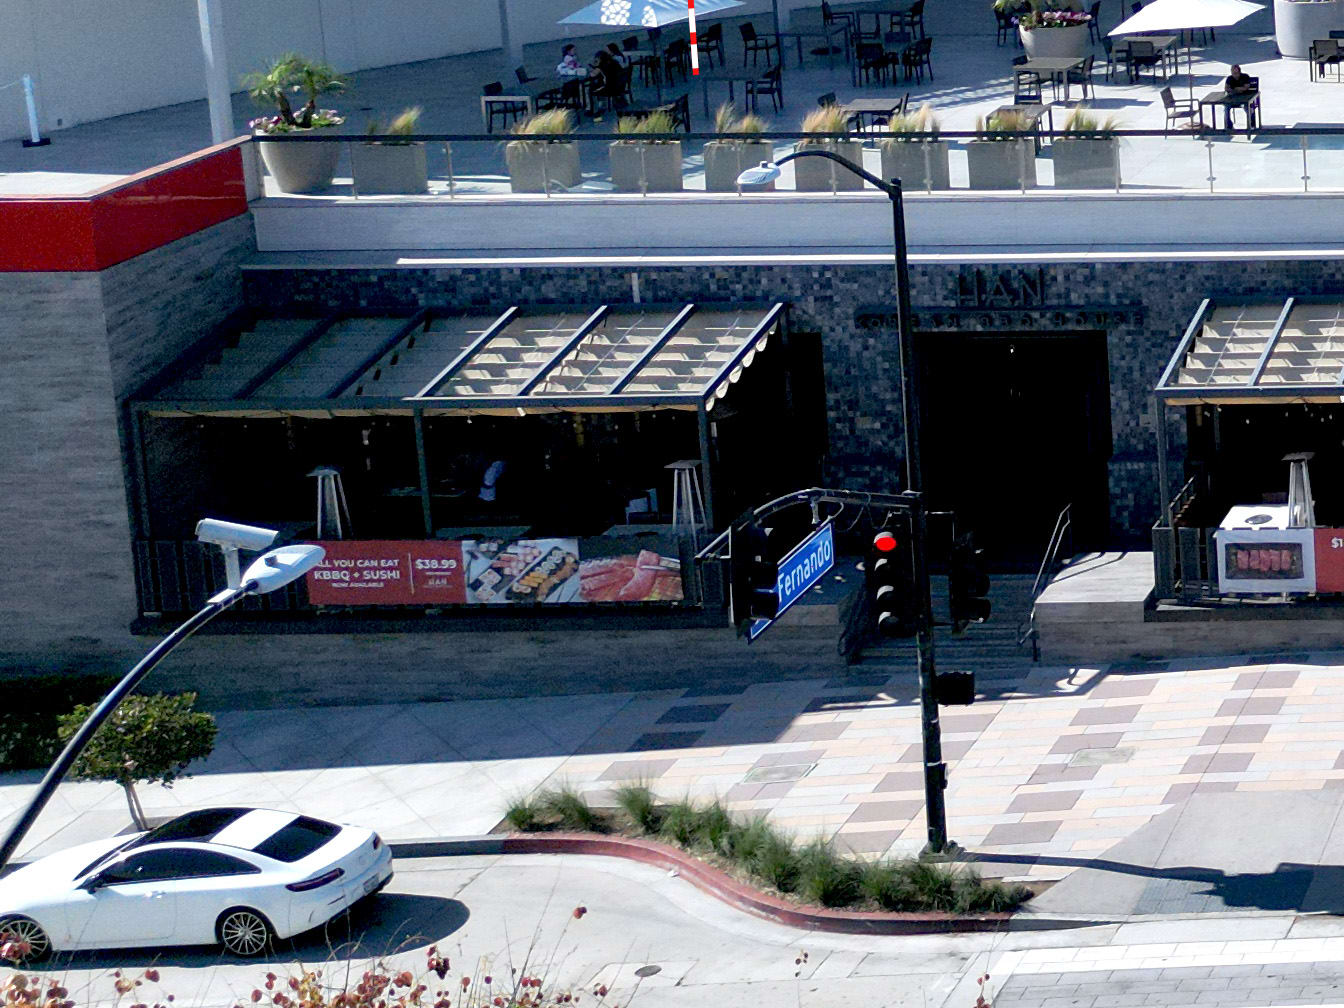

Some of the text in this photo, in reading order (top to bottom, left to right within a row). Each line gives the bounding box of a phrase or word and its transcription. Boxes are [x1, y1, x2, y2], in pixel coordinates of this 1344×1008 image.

[333, 559, 355, 568] YOU
[357, 559, 378, 567] CAN
[381, 559, 400, 567] EAT
[414, 558, 458, 570] $38.99
[313, 570, 350, 581] KBBQ
[363, 570, 401, 580] SUSHI
[777, 540, 830, 603] Fernando
